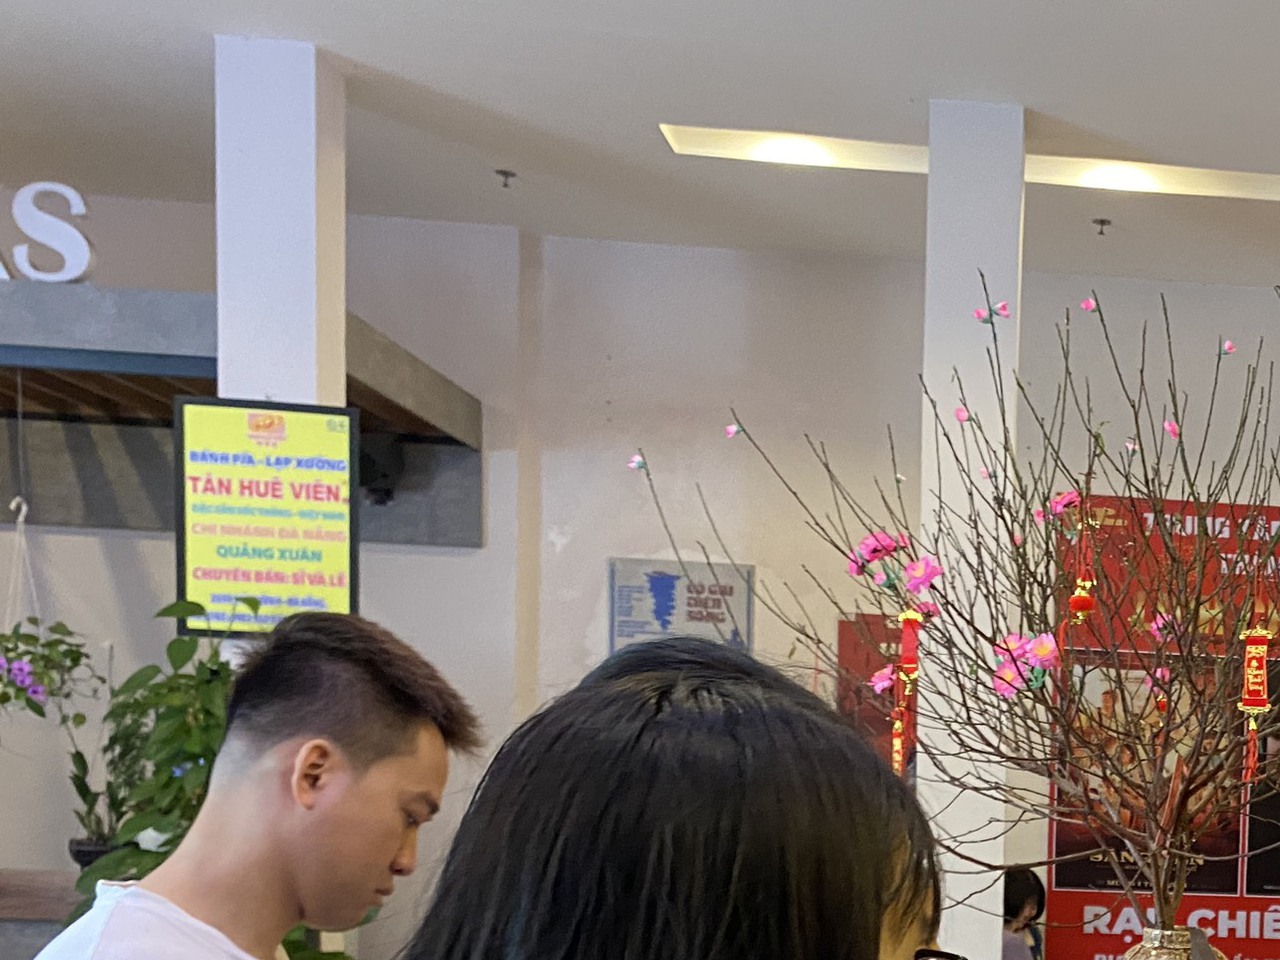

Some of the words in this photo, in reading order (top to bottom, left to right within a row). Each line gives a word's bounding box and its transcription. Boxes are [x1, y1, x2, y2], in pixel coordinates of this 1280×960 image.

[0, 181, 91, 282] S
[188, 473, 232, 495] TÂN
[239, 476, 283, 499] HUÊ
[289, 479, 341, 503] VIÊN
